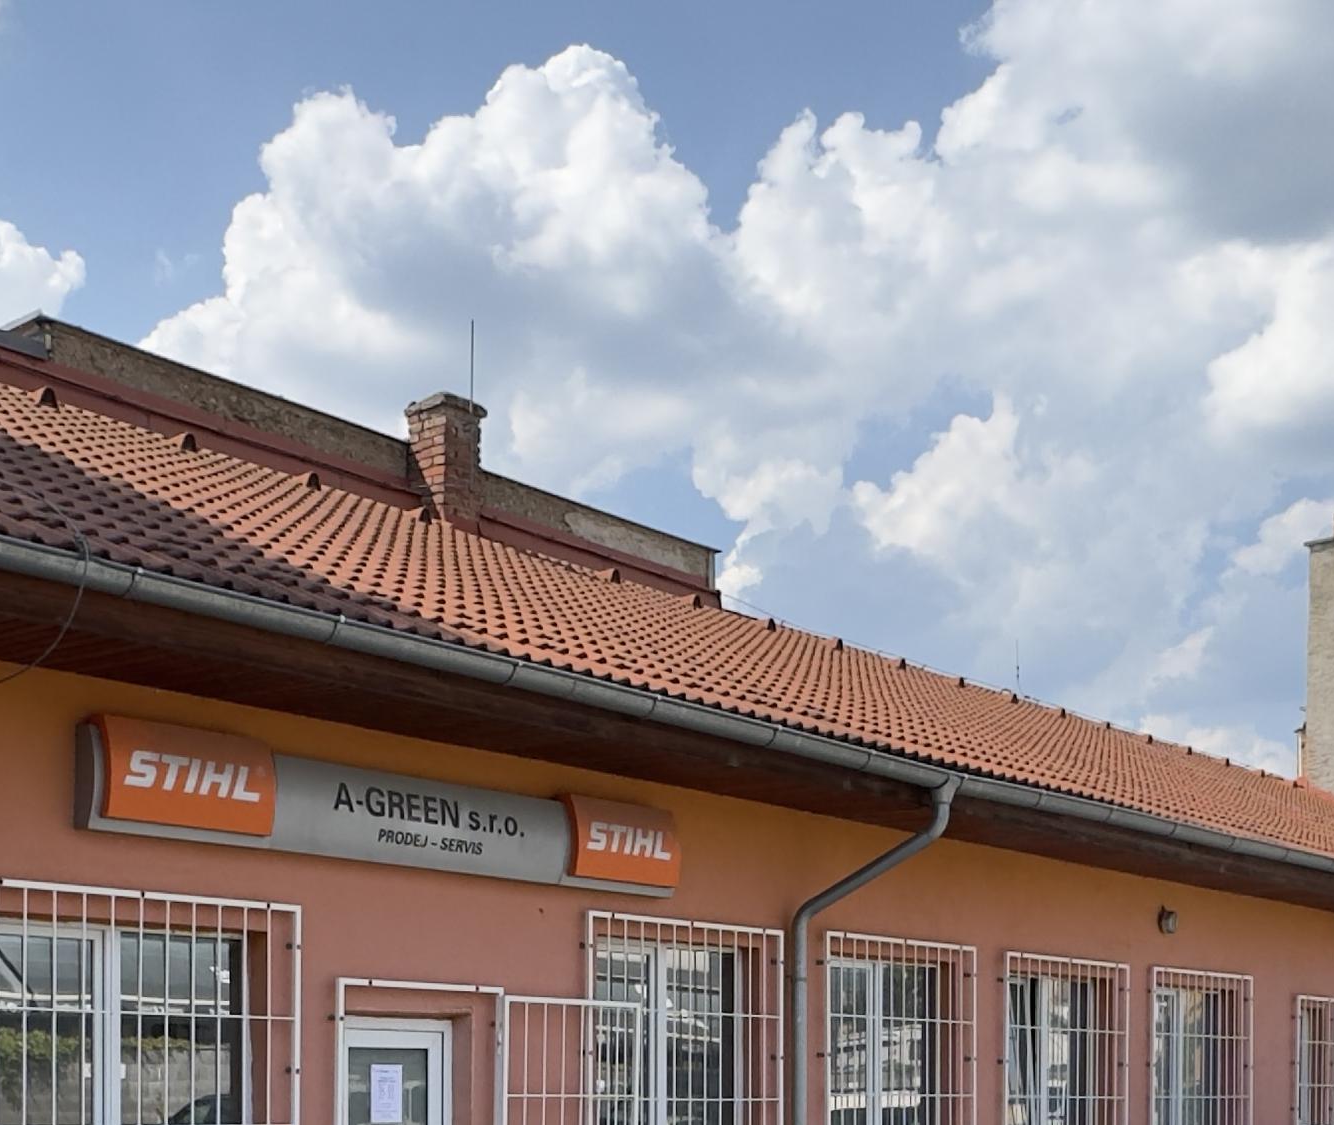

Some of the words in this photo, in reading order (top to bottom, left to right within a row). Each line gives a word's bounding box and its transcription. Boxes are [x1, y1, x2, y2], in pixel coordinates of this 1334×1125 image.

[123, 750, 261, 803] STIHL
[333, 782, 460, 829] A-GREEN
[468, 809, 525, 838] s.r.o.
[377, 828, 429, 848] PRODEJ
[439, 837, 483, 856] SERVIS
[586, 821, 672, 861] STIHL
